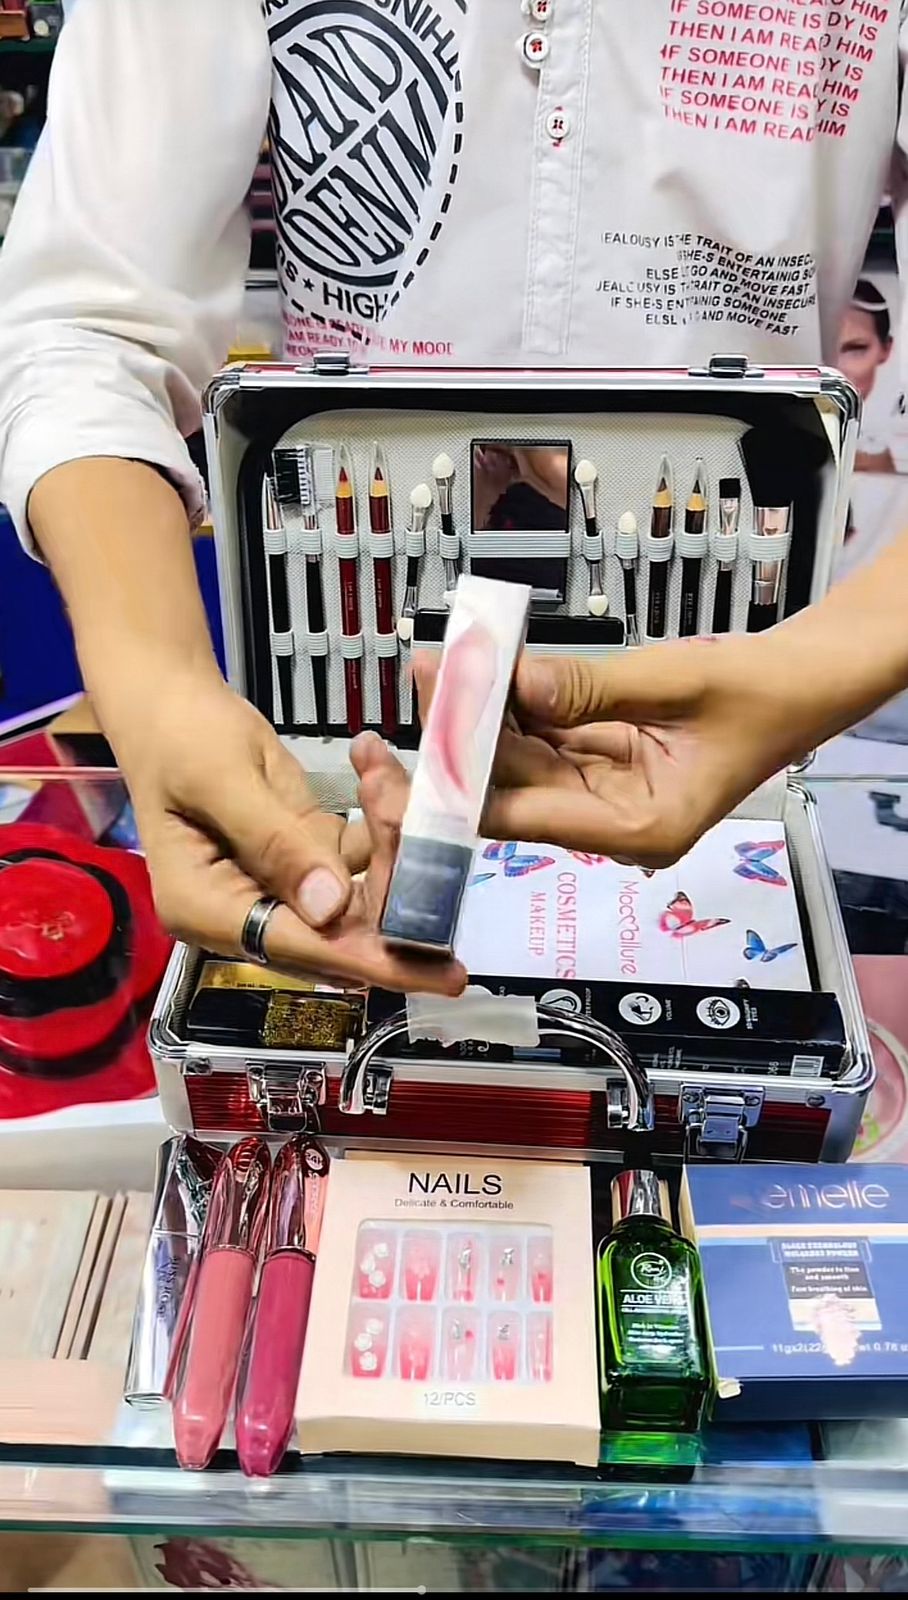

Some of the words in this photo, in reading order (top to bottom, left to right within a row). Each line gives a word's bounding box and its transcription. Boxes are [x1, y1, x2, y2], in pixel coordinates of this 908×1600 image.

[697, 0, 798, 26] SOMEONE
[803, 13, 821, 30] IS
[859, 23, 879, 42] IS
[669, 20, 725, 41] THEN
[731, 26, 737, 42] I
[741, 27, 774, 46] AM
[780, 32, 821, 51] REA
[836, 36, 873, 62] HIM
[688, 47, 790, 72] SOMEONE
[797, 60, 815, 76] IS
[844, 63, 864, 81] IS
[661, 66, 715, 87] THEN
[722, 72, 728, 88] I
[732, 74, 765, 92] AM
[822, 78, 859, 101] HIM
[267, 25, 402, 213] RAND
[661, 104, 708, 130] THEN
[714, 115, 720, 130] I
[725, 117, 757, 135] AM
[681, 90, 784, 116] SOMEONE
[790, 103, 809, 120] IS
[830, 101, 850, 117] IS
[283, 78, 437, 267] DENIM
[664, 235, 674, 248] IS
[696, 235, 733, 256] TRAIT
[735, 252, 753, 264] OF
[755, 256, 775, 268] AN
[777, 253, 814, 267] INSEC
[646, 266, 679, 281] ELSE
[710, 267, 738, 283] AND
[740, 279, 778, 296] MOVE
[781, 283, 810, 296] FAST
[664, 283, 676, 296] IS
[722, 283, 741, 295] OF
[741, 292, 761, 304] AN
[611, 296, 622, 308] IF
[724, 297, 788, 323] SOMEONE
[726, 311, 763, 328] MOVE
[765, 323, 799, 335] FAST
[389, 338, 408, 353] MY
[528, 890, 546, 956] MAKEUP
[555, 872, 577, 979] COSMETICS
[408, 1172, 502, 1195] NAILS
[395, 1198, 436, 1208] Delicate
[439, 1199, 447, 1208] &
[450, 1199, 513, 1210] Comfortable
[622, 1294, 653, 1305] ALOE
[423, 1392, 476, 1407] 12/PCS
